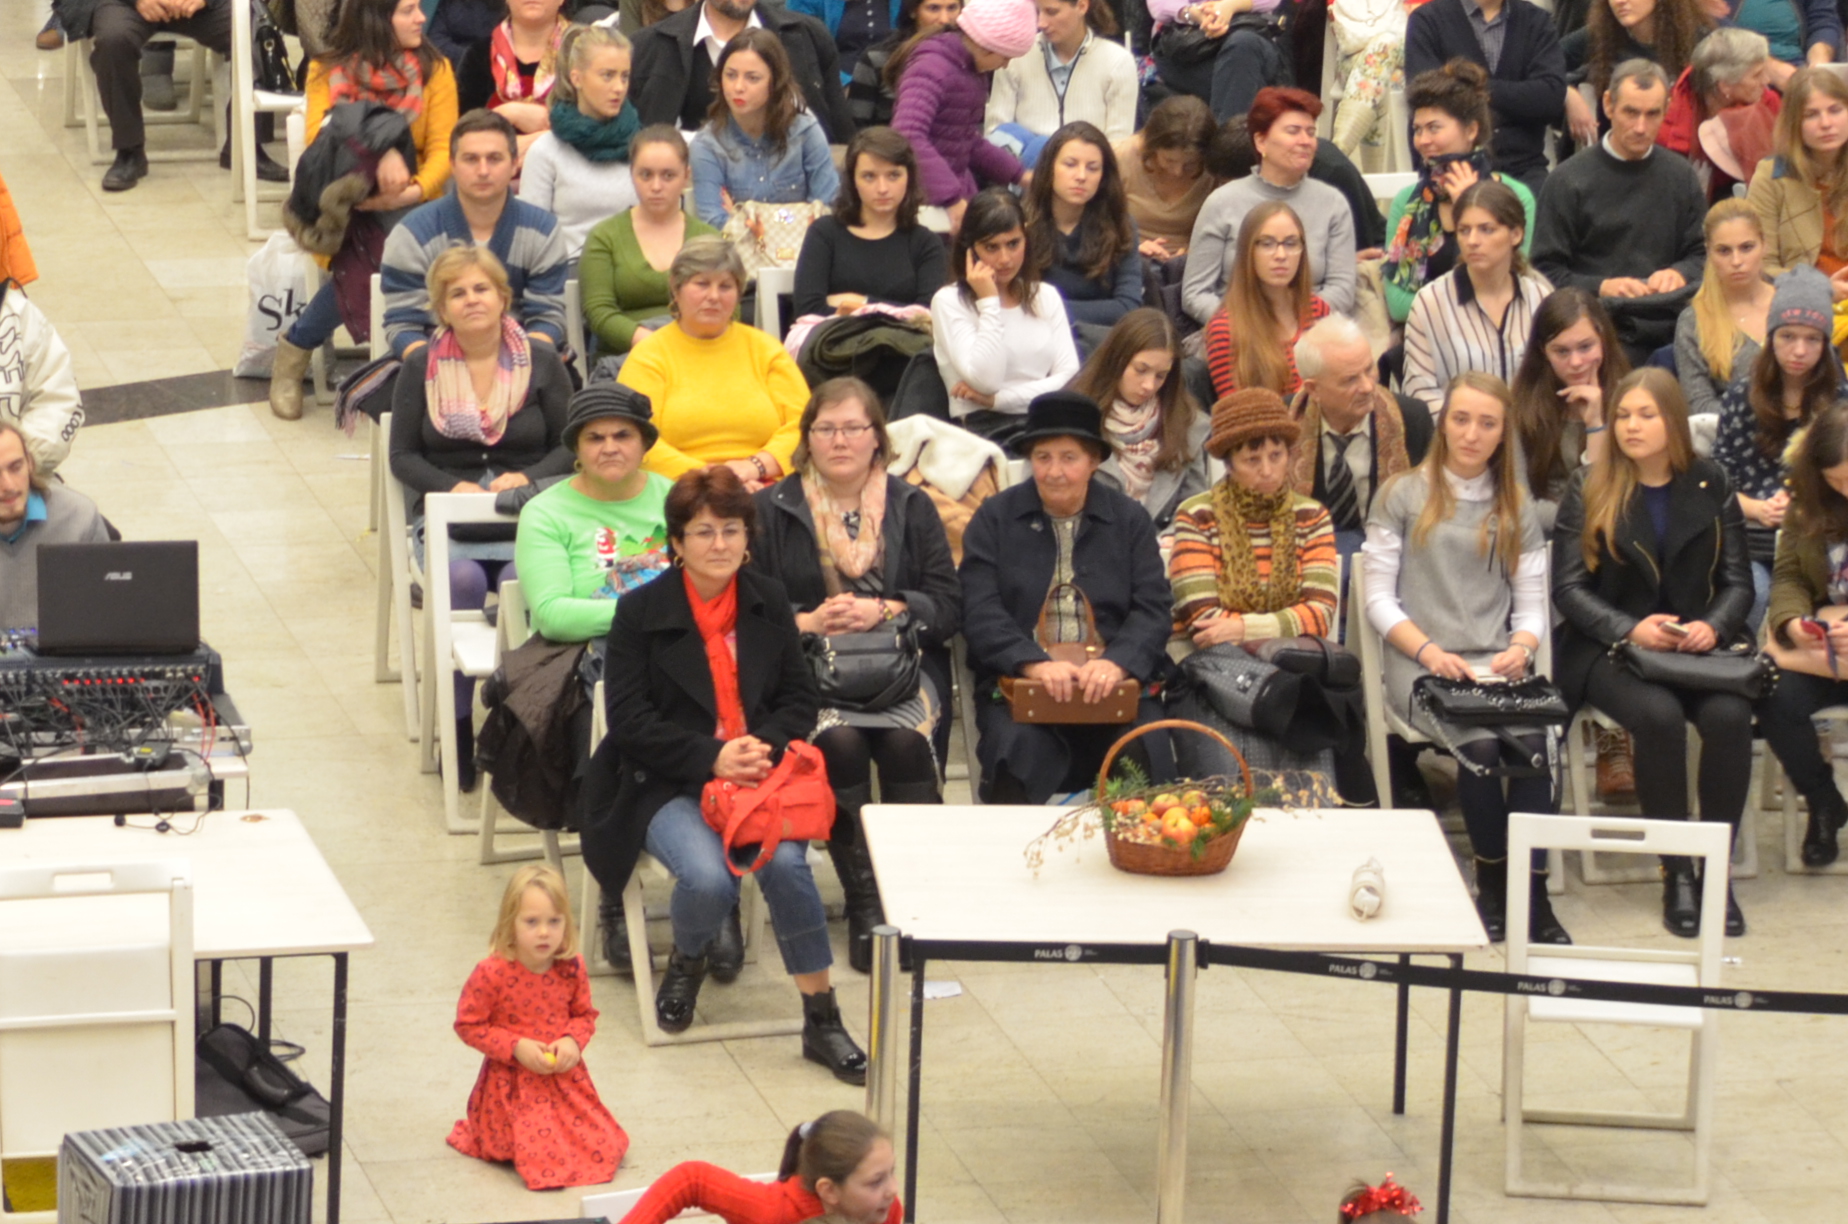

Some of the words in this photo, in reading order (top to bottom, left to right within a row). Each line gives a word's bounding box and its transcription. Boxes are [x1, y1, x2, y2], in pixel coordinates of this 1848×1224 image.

[104, 572, 133, 581] ASUS
[1034, 948, 1063, 959] PALAS
[1328, 963, 1358, 976] PALAS
[1516, 981, 1547, 993] PALAS
[1703, 994, 1734, 1006] PALAS
